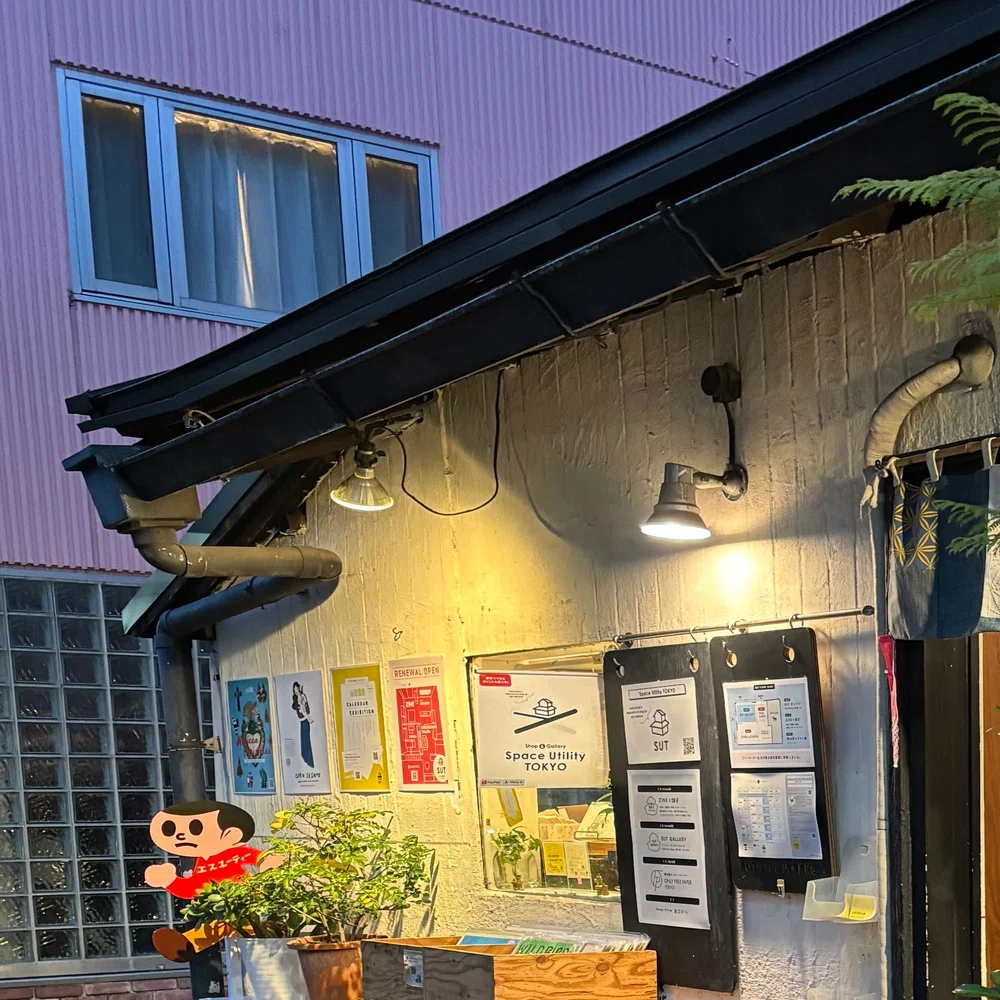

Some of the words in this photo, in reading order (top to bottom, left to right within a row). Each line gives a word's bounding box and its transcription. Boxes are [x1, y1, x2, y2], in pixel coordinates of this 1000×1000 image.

[394, 667, 422, 678] RENEWAL
[424, 666, 440, 675] OPEN
[653, 740, 669, 752] SUT
[505, 751, 545, 762] Space
[549, 750, 586, 762] Utility
[436, 766, 446, 774] SUT
[524, 762, 567, 771] TOKYO
[196, 852, 252, 874] エスユーティー
